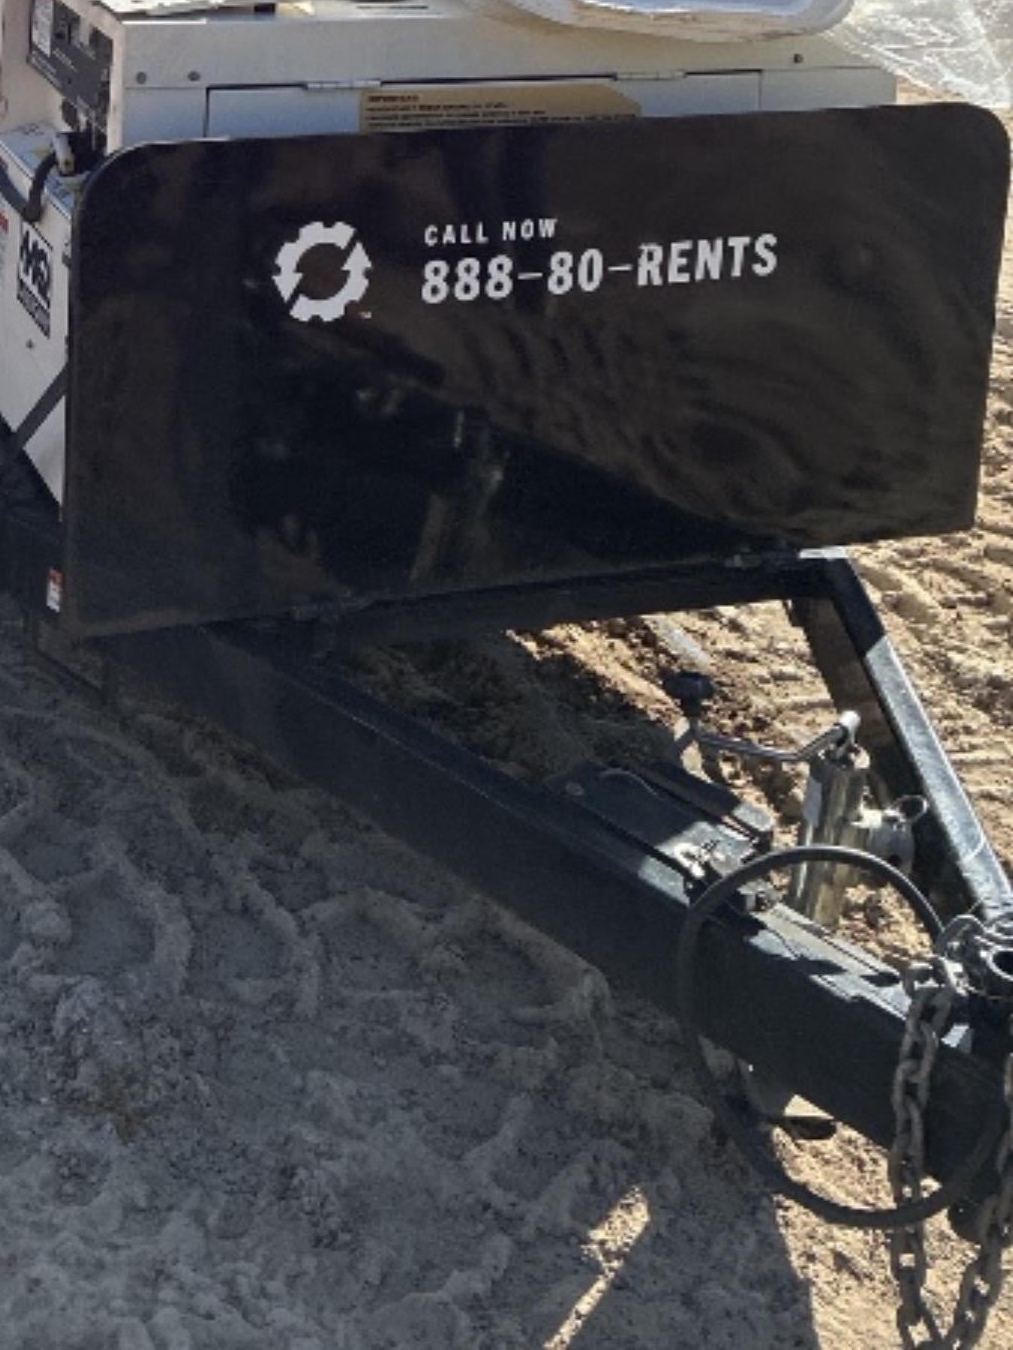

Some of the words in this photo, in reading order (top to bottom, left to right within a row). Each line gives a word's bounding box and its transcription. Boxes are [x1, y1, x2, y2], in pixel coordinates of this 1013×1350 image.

[424, 223, 488, 246] CALL
[502, 218, 558, 242] NOW
[420, 234, 778, 304] 888-80-RENTS
